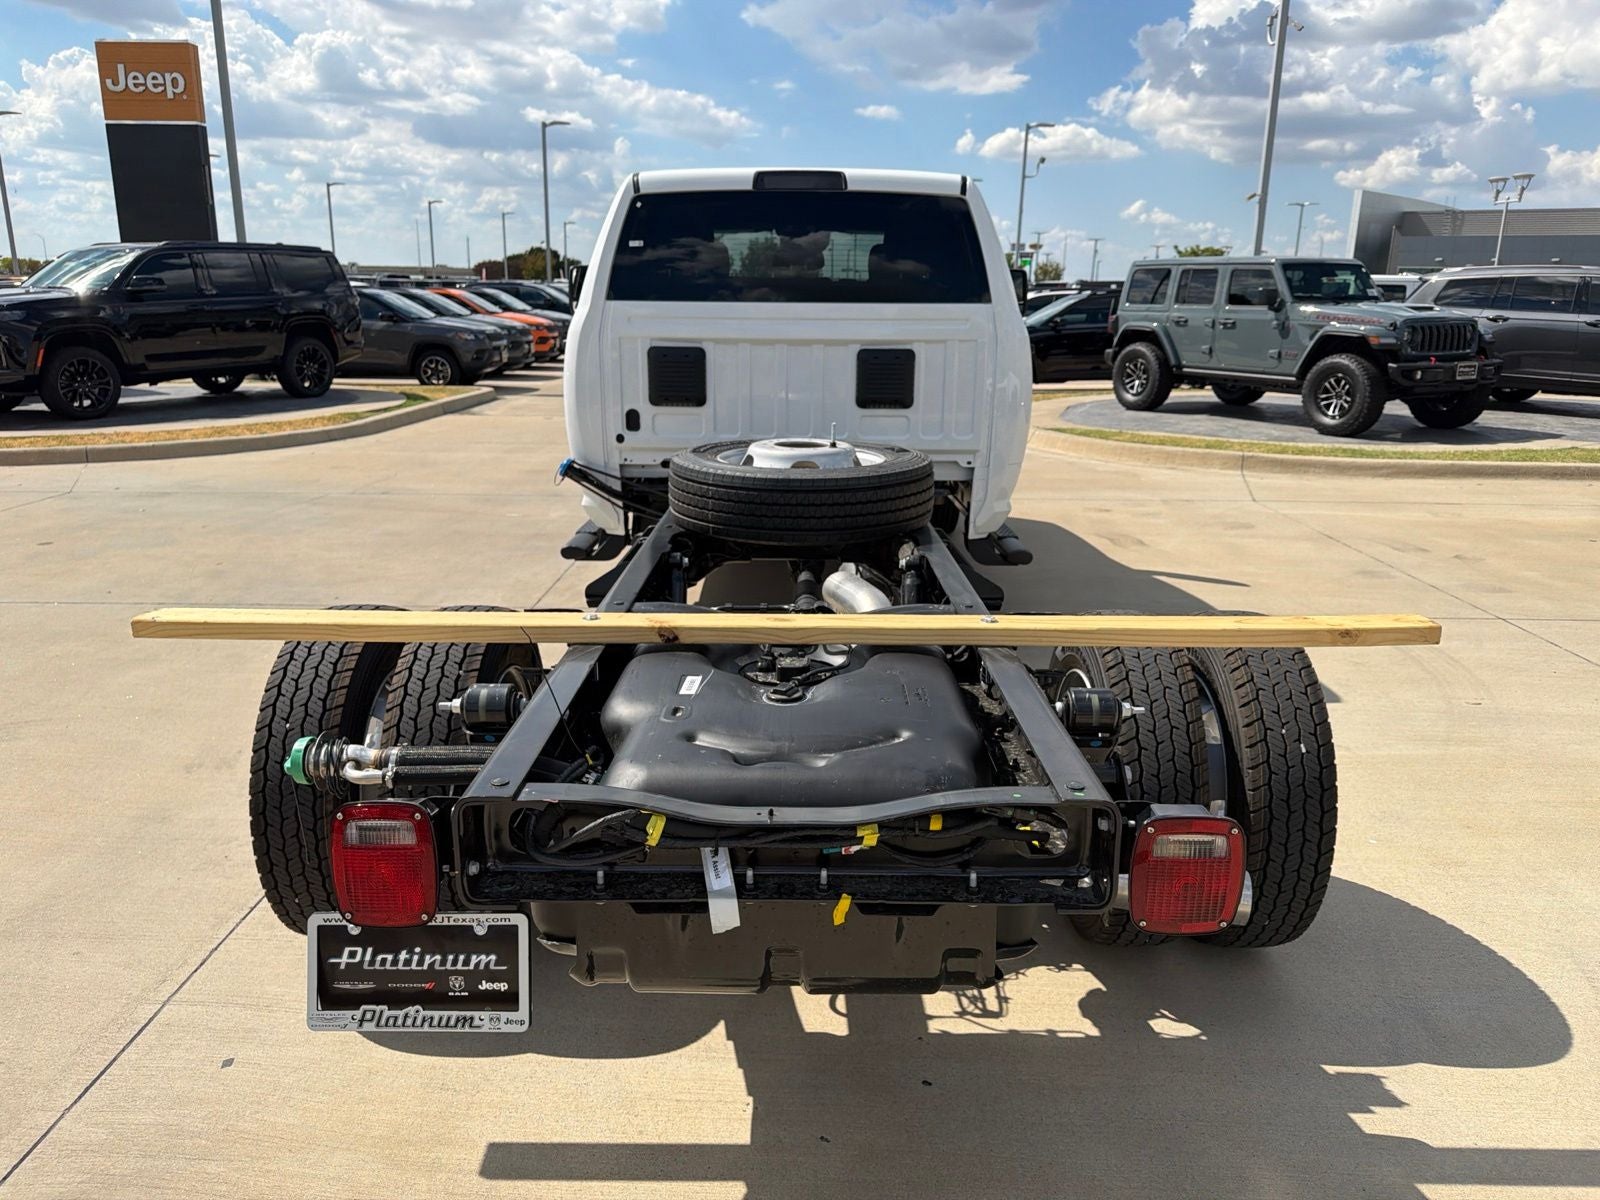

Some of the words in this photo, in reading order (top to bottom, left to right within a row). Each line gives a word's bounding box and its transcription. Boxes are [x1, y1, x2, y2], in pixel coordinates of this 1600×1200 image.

[105, 63, 186, 99] Jeep
[327, 946, 508, 971] Platinum
[478, 980, 509, 992] Jeep
[357, 1008, 485, 1030] Platinum
[503, 1017, 526, 1027] Jeep
